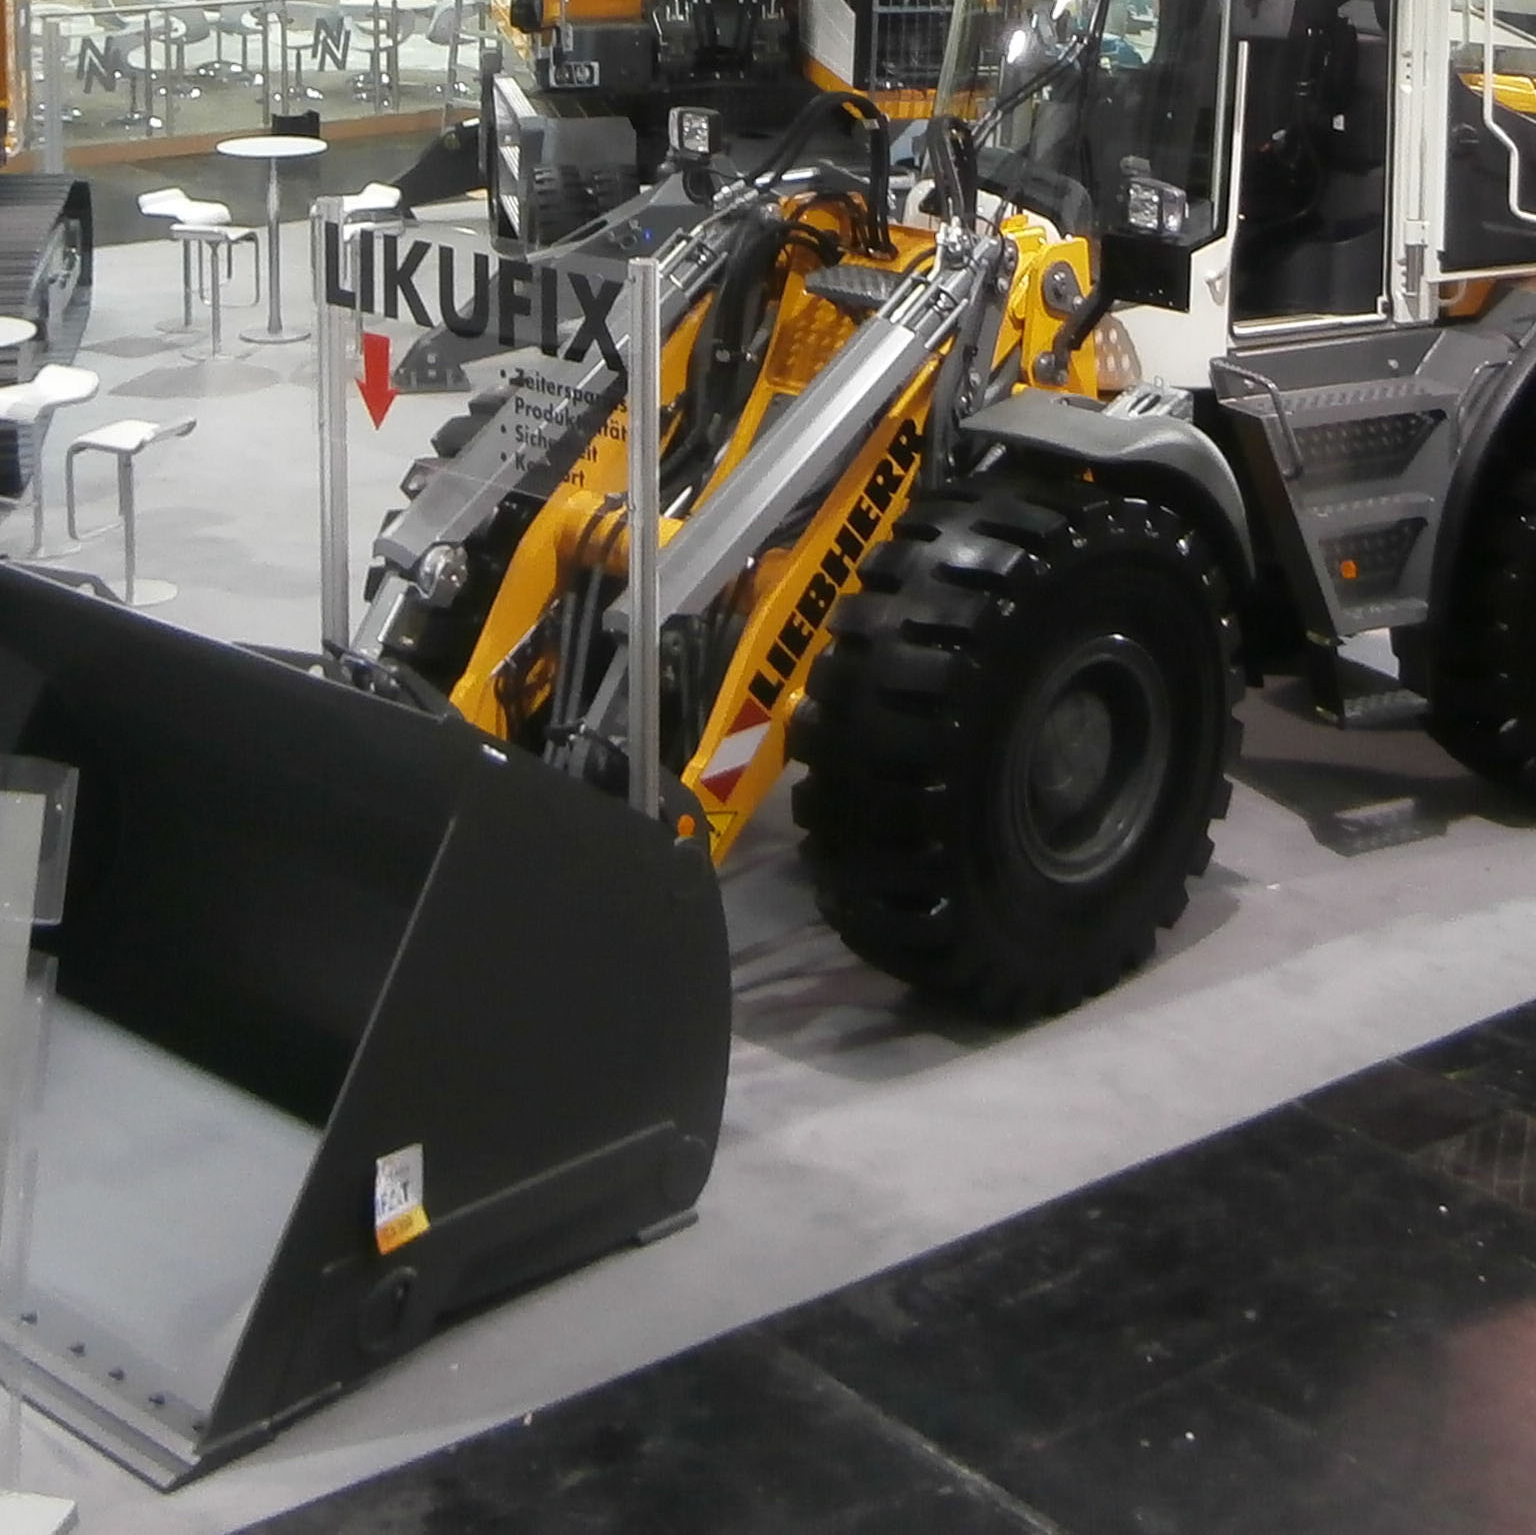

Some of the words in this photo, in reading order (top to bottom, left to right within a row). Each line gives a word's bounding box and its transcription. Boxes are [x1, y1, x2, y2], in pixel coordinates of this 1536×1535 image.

[324, 221, 628, 395] LIKUFIX
[515, 396, 628, 442] Produktät
[748, 418, 925, 711] LIEBHERR
